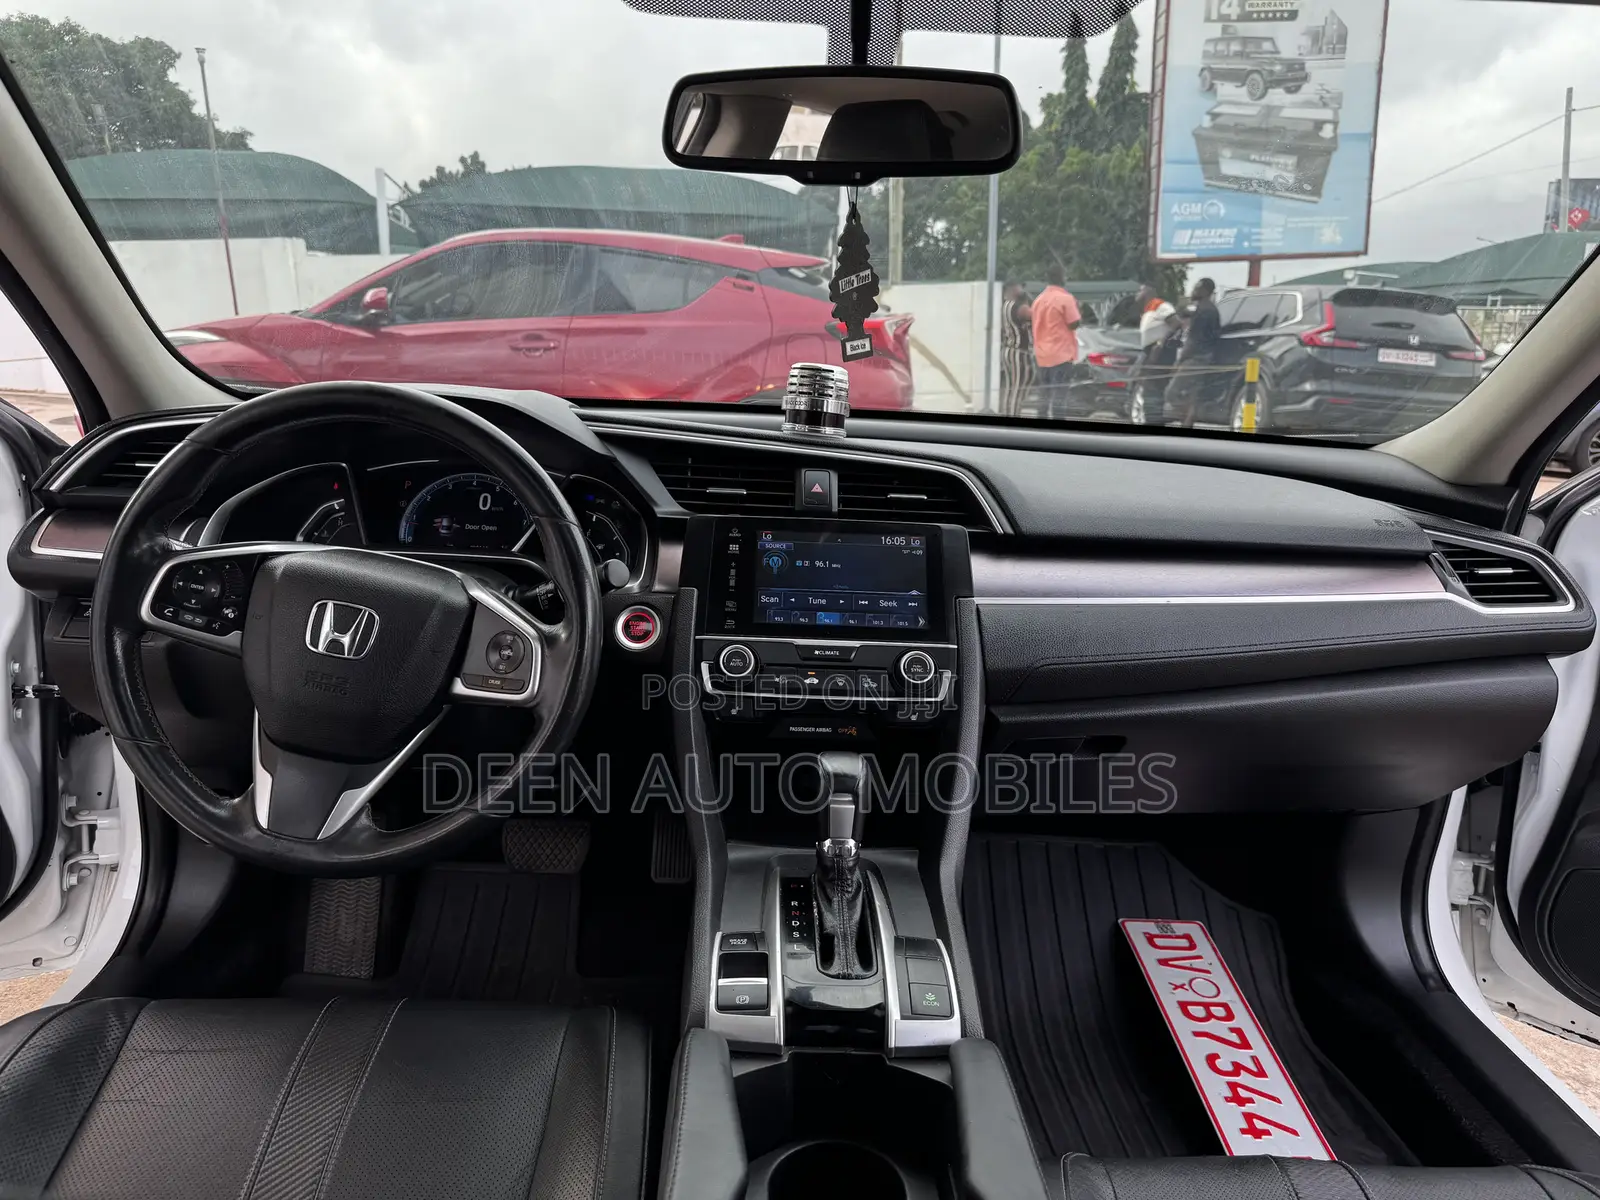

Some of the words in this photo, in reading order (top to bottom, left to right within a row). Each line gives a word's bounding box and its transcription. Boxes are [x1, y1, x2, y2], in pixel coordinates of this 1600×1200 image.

[1209, 0, 1241, 21] 14
[1171, 202, 1203, 215] AGM
[840, 277, 855, 292] Little
[855, 272, 871, 286] Trees
[849, 343, 861, 352] Black
[478, 492, 493, 511] 0
[464, 523, 480, 531] Door
[481, 524, 498, 532] Open
[880, 536, 906, 546] 16:05
[910, 538, 921, 546] Lo
[814, 560, 830, 568] 96.1
[190, 583, 205, 591] ENTER
[760, 595, 780, 604] Scan
[808, 596, 827, 605] Tune
[879, 599, 898, 608] Seek
[792, 920, 800, 928] D
[794, 943, 801, 951] L
[922, 1000, 940, 1008] ECON
[1176, 1000, 1301, 1142] B7344
